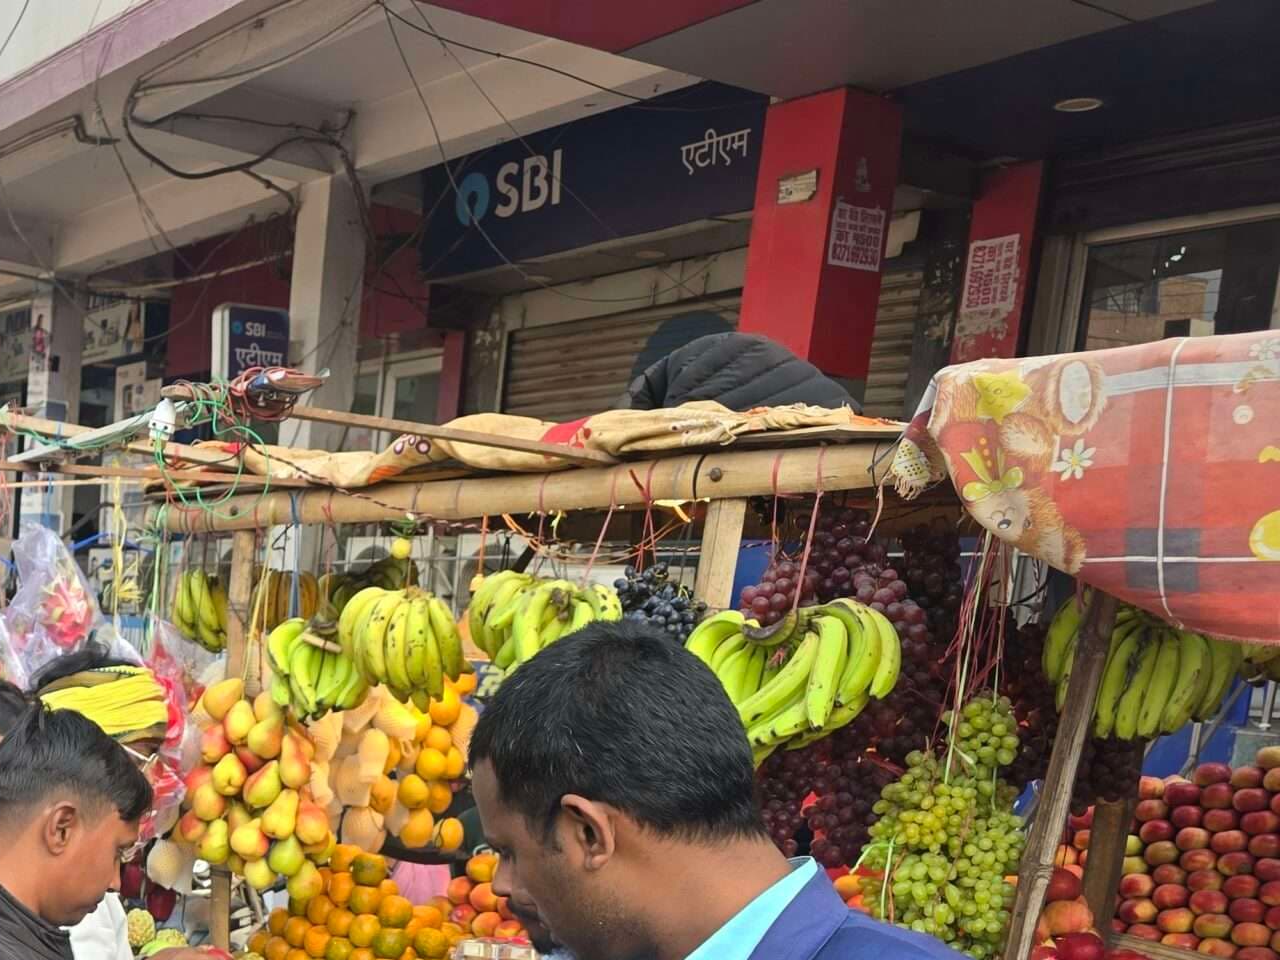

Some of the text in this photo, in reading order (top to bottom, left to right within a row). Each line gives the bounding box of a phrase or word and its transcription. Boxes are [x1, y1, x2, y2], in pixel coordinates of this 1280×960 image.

[680, 128, 752, 175] एटीएम
[494, 148, 563, 218] SBI
[245, 321, 267, 337] SBI
[235, 342, 284, 369] एटीएम
